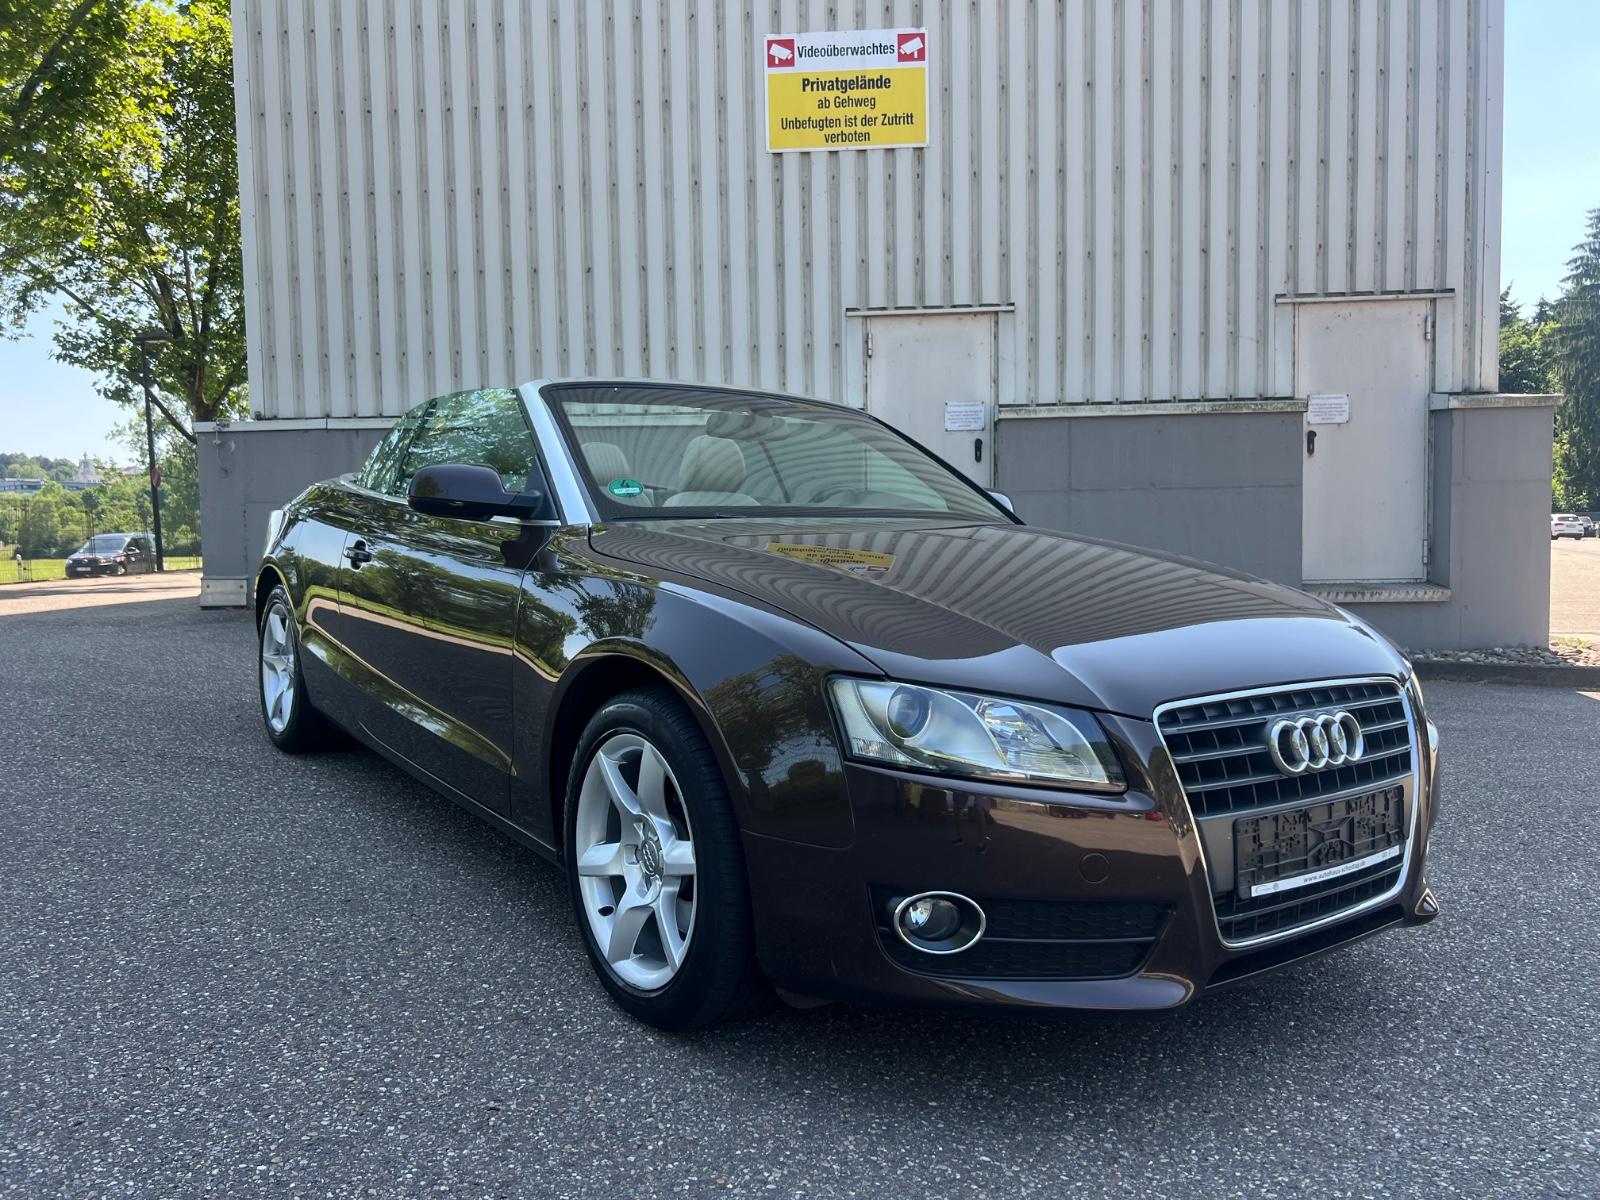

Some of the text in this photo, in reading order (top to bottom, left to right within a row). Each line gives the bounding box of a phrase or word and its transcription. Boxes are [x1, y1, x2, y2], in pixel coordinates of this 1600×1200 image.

[797, 43, 895, 58] Videoüberwachtes
[802, 75, 891, 93] Privatgelände
[817, 96, 876, 109] ab Gehweg
[781, 113, 914, 131] Unbefugten ist der Zutritt
[824, 131, 870, 143] verboten
